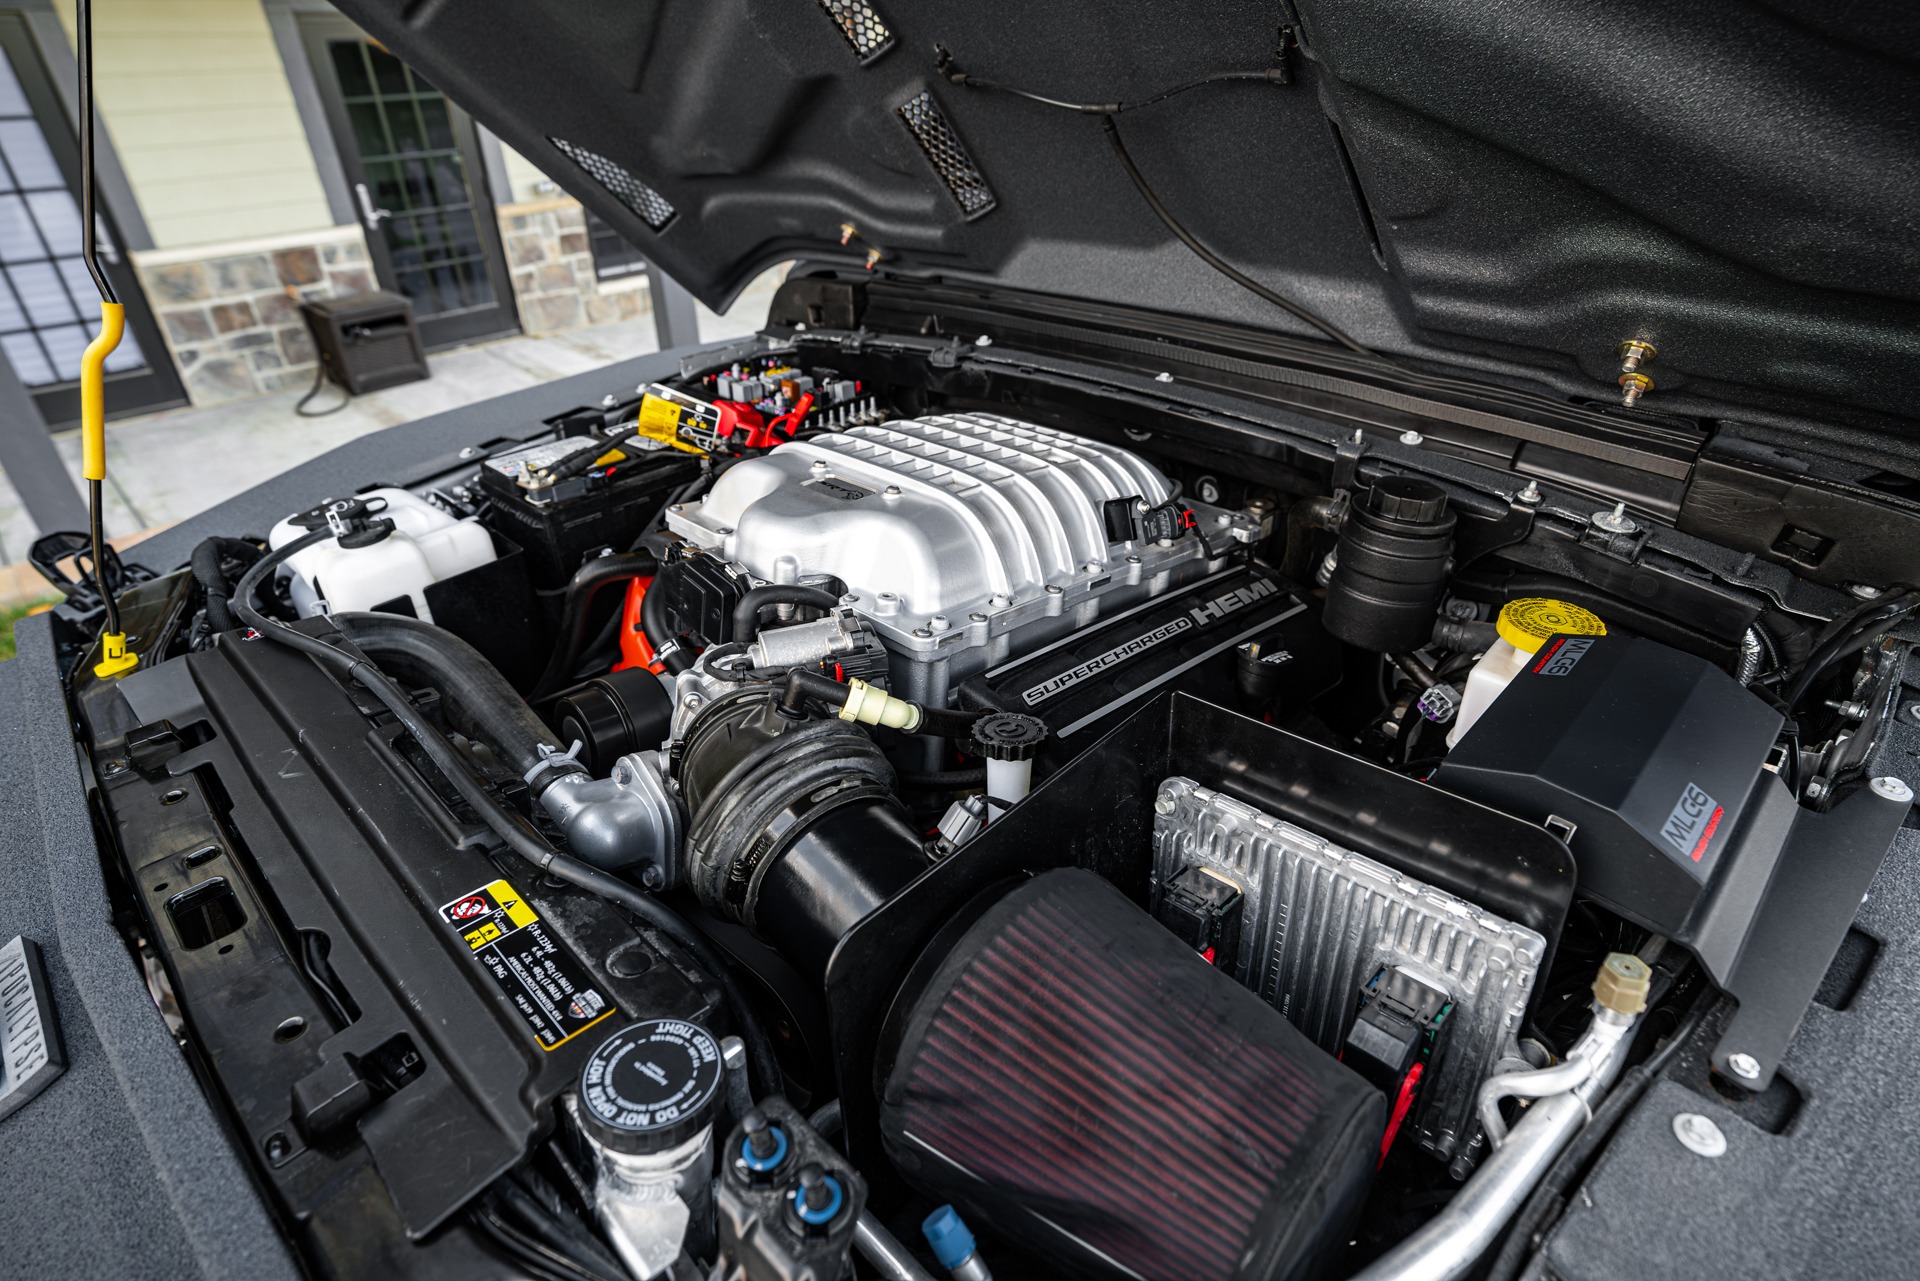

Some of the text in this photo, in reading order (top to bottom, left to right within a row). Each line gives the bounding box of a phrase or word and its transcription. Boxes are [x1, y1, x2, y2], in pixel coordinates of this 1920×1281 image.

[1026, 578, 1278, 702] SUPERCHARGED HEMI
[1548, 639, 1592, 674] MLG6
[1664, 785, 1709, 848] MLG6
[531, 946, 544, 958] 6.4L
[532, 929, 557, 954] R-1234yf
[493, 963, 508, 979] PAG
[508, 956, 530, 978] AMERICAS
[525, 976, 539, 991] MOST
[536, 988, 556, 1011] WANTED
[0, 952, 44, 1081] APOCALYPSE
[655, 1022, 717, 1062] KEEP TIGHT
[587, 1057, 680, 1126] DO NOT OPEN HOT
